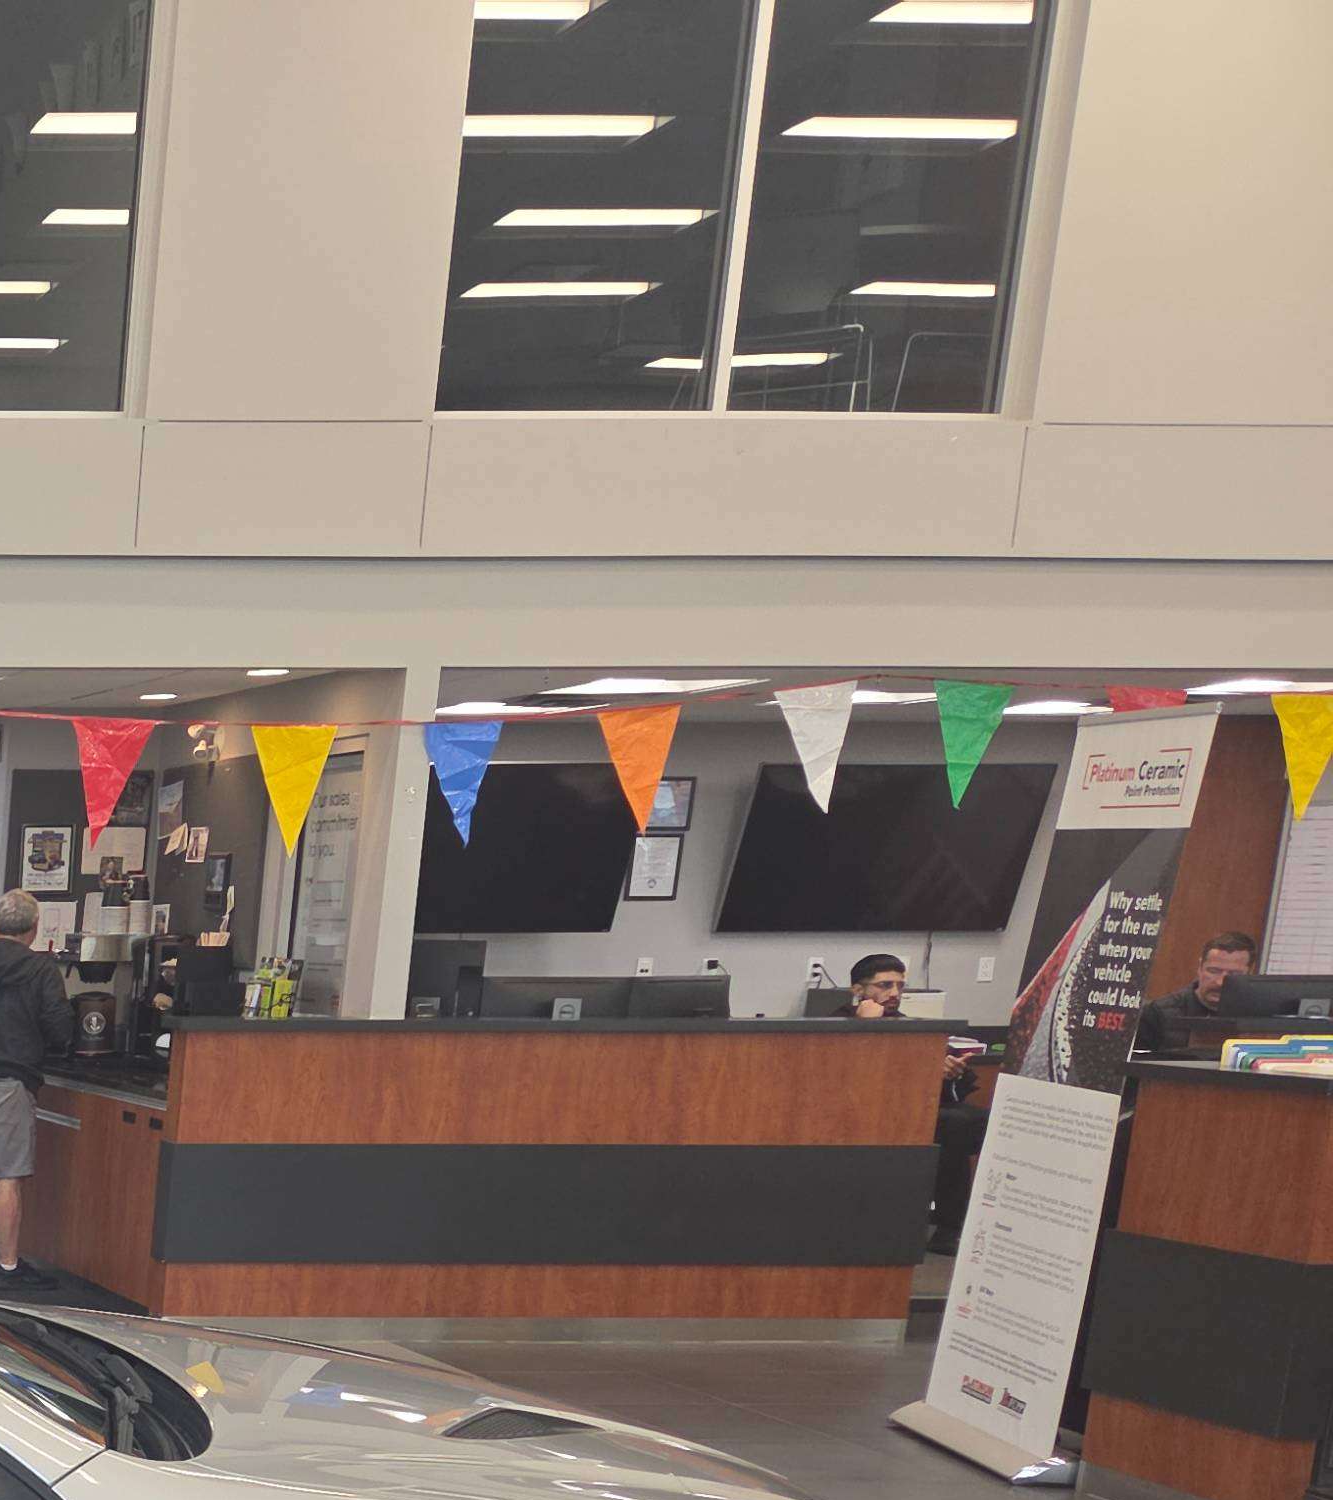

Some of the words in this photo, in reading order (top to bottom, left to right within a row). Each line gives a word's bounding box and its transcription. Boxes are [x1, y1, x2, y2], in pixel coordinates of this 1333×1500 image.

[1090, 763, 1135, 782] Platinum
[1138, 759, 1185, 780] Ceramic
[1144, 785, 1180, 796] Protection
[1109, 891, 1133, 914] Why
[1134, 892, 1163, 912] settle
[1103, 914, 1121, 933] for
[1121, 916, 1141, 935] the
[1099, 939, 1128, 958] when
[1129, 946, 1153, 964] your
[1094, 962, 1132, 982] vehicle
[1088, 986, 1119, 1005] could
[1119, 988, 1141, 1009] look
